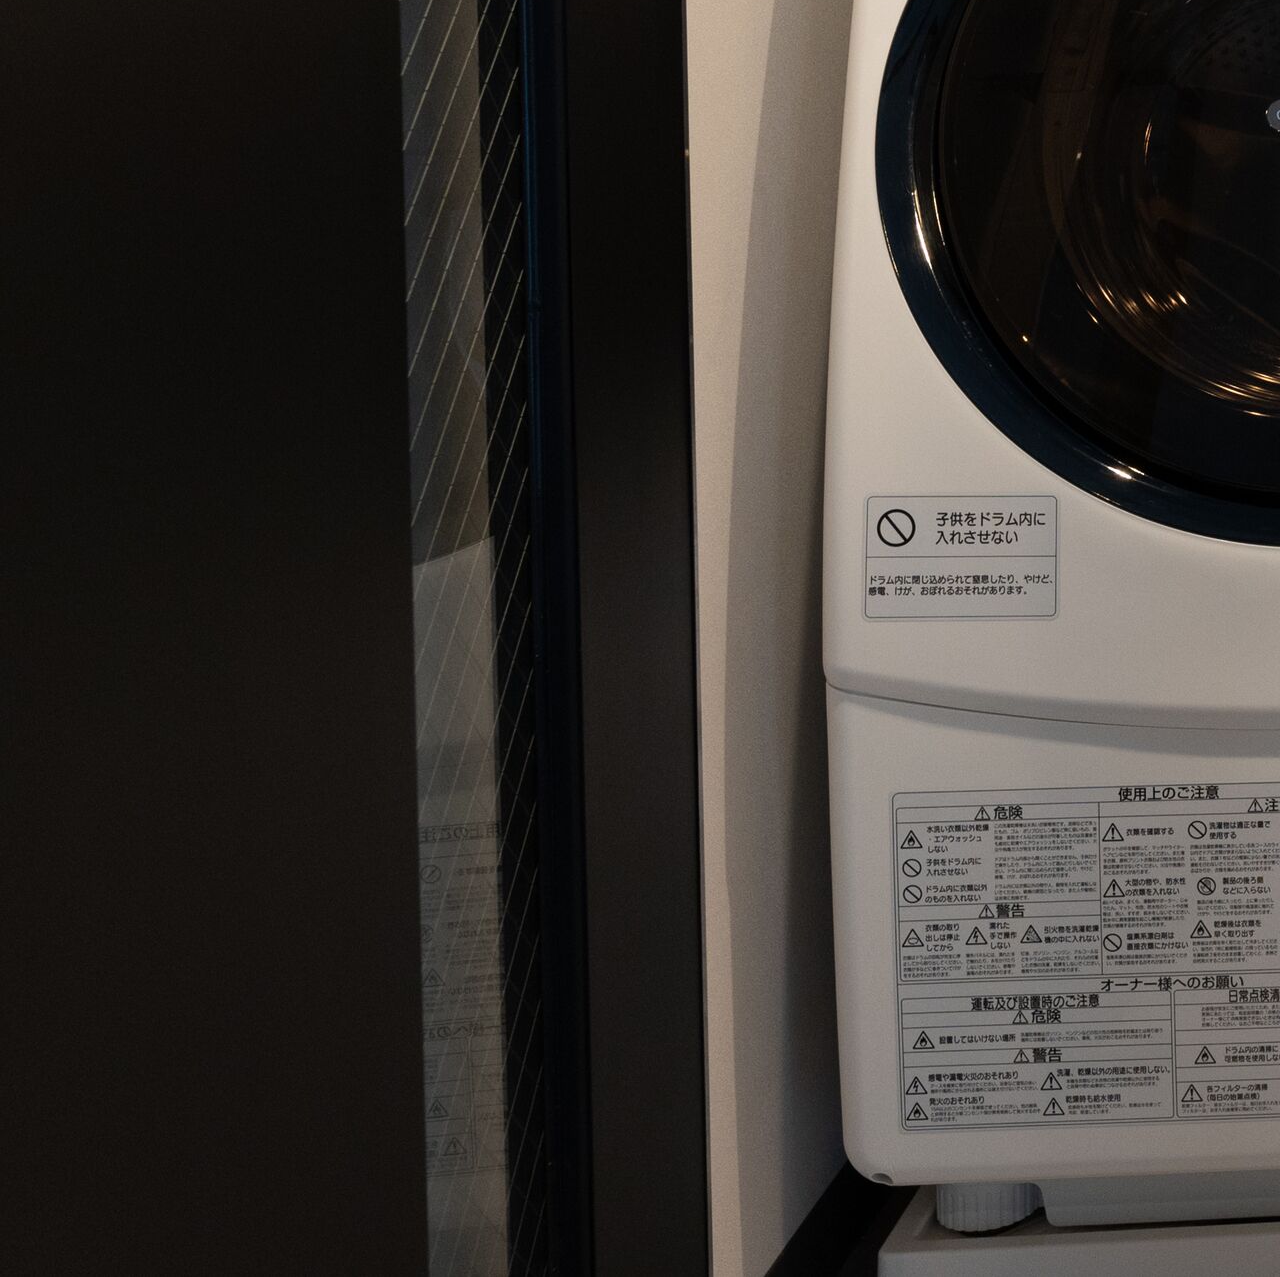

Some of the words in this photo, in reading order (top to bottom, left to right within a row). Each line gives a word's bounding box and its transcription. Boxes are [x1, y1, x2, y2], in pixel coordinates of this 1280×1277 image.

[936, 513, 1046, 527] 子供をドラム内に
[936, 531, 1018, 545] 入れさせない
[1118, 785, 1219, 801] 使用上のご注意
[994, 806, 1023, 820] 危険
[996, 904, 1024, 918] 警告
[1100, 975, 1244, 991] オーナー様へのお願い
[971, 994, 1099, 1011] 運転及び設置時のご注意
[1031, 1010, 1061, 1023] 危険
[1033, 1048, 1062, 1062] 警告
